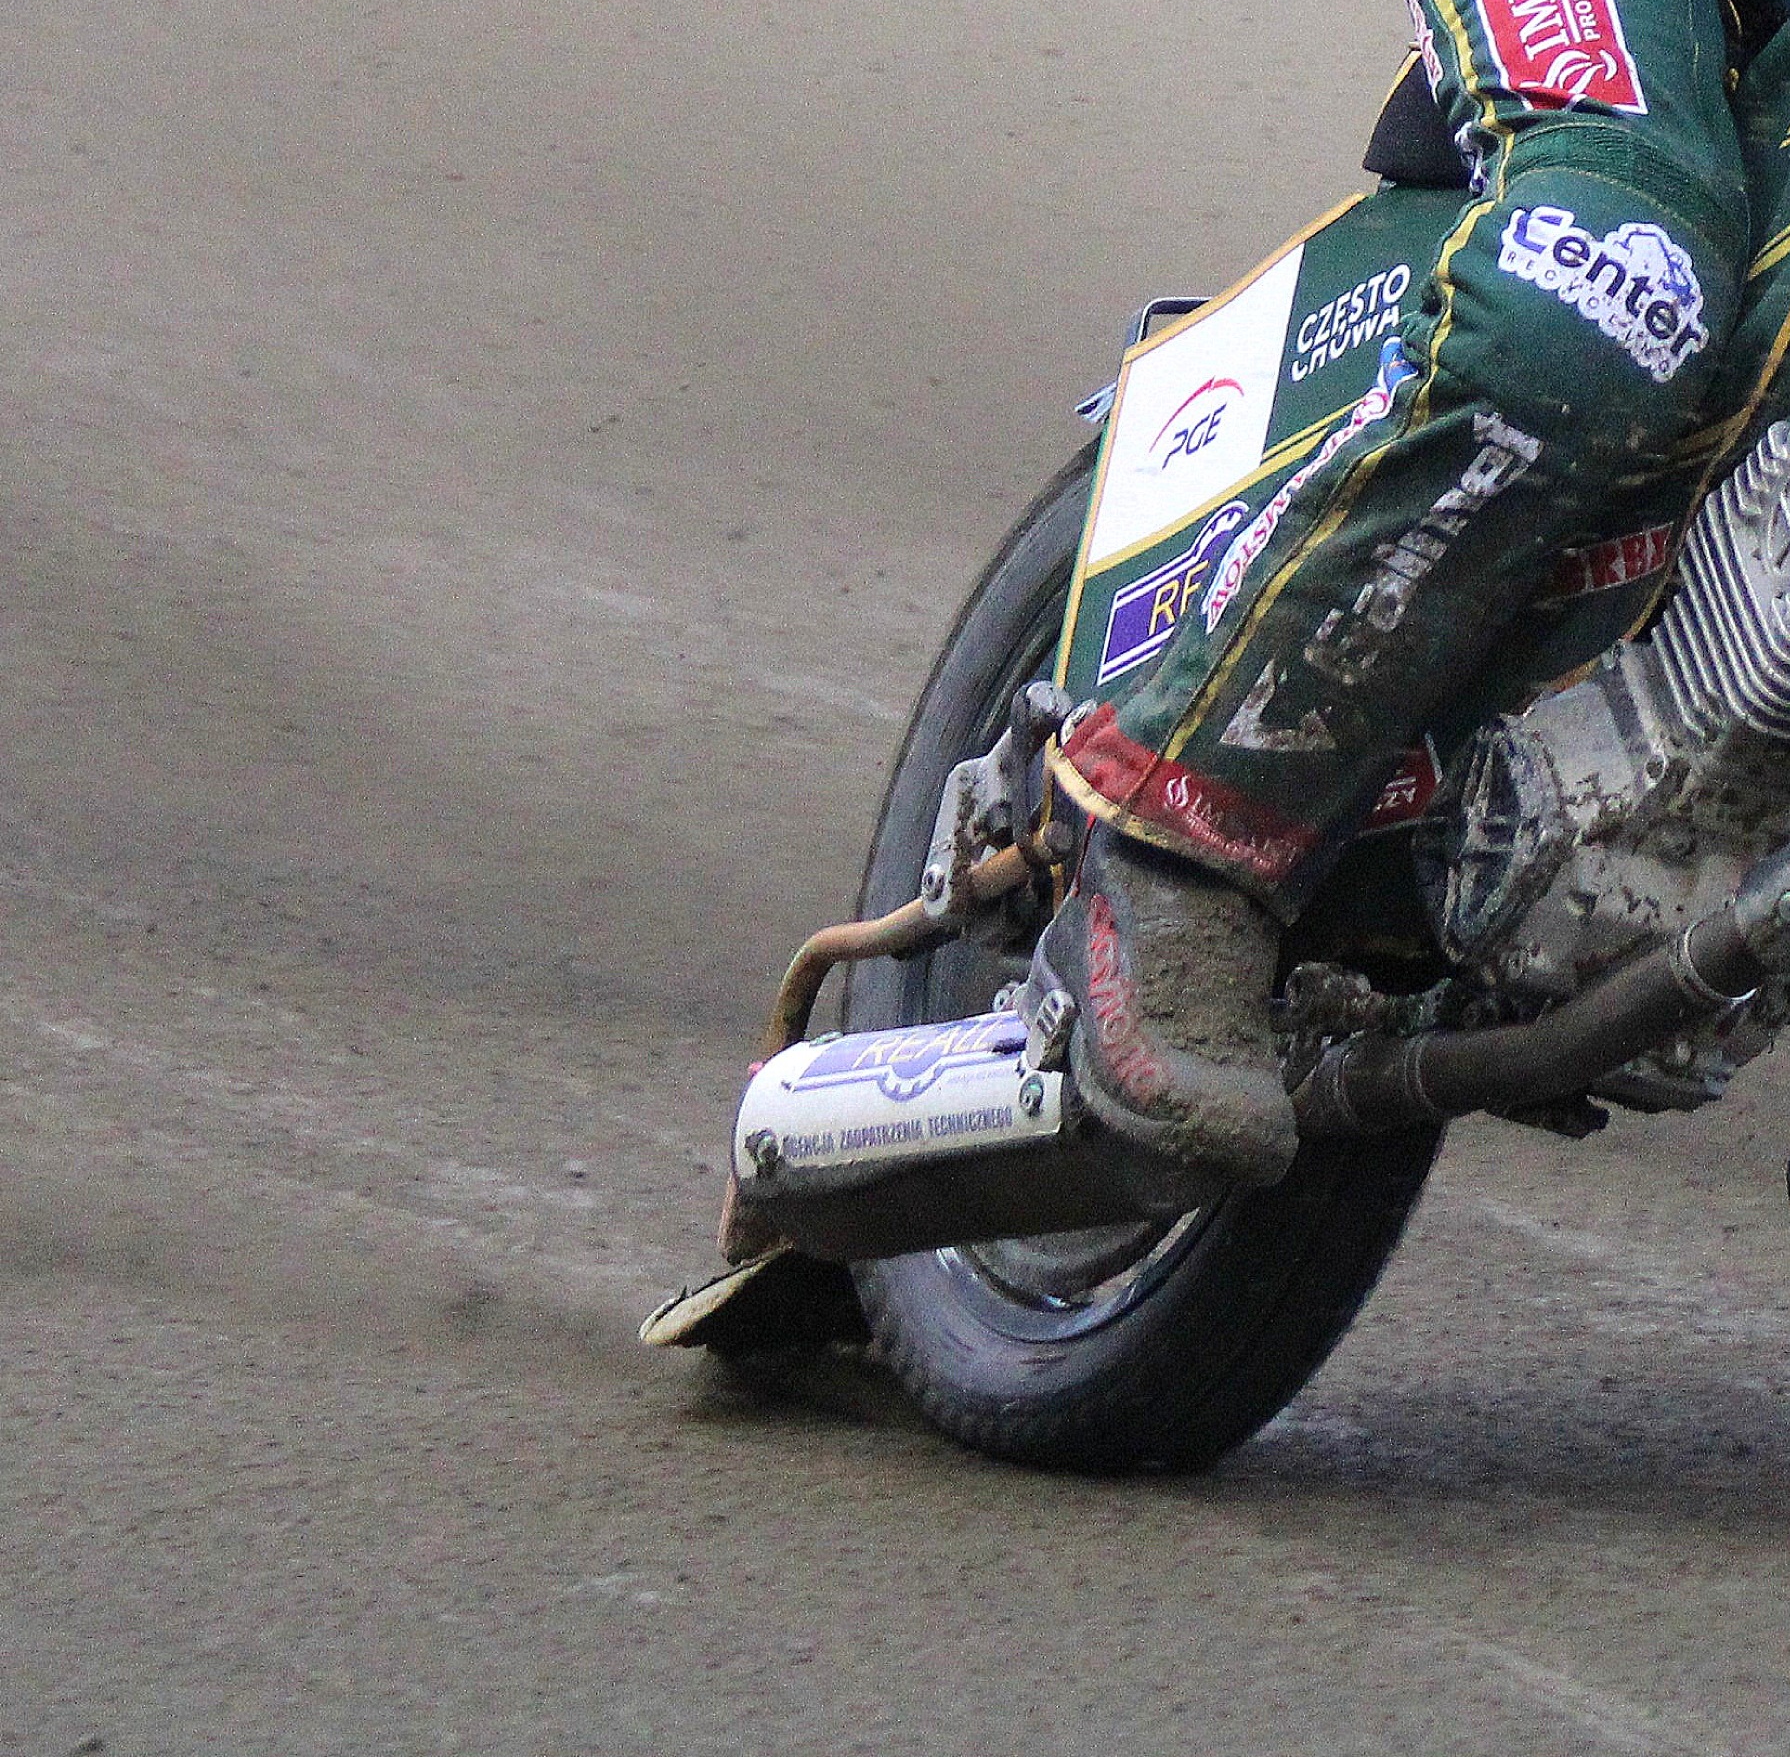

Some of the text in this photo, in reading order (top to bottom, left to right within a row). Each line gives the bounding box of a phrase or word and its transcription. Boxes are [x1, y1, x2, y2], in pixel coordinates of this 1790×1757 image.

[1512, 210, 1702, 357] Center
[1161, 402, 1228, 470] PGE
[855, 1023, 999, 1067] REALL
